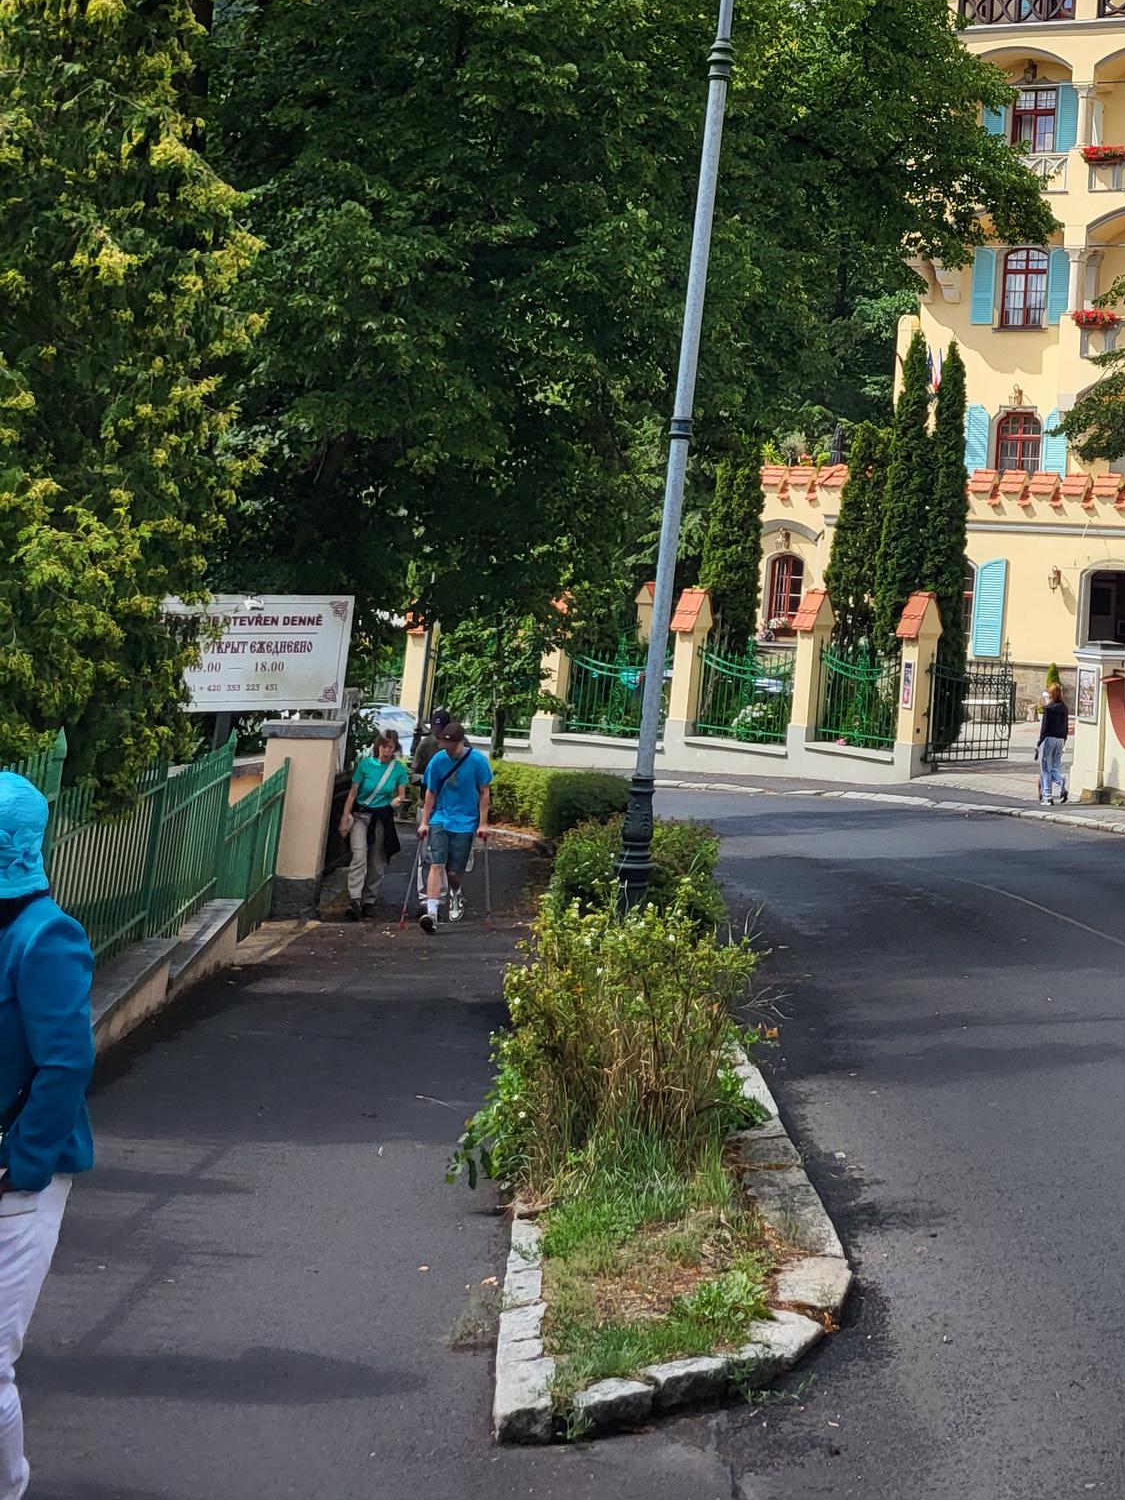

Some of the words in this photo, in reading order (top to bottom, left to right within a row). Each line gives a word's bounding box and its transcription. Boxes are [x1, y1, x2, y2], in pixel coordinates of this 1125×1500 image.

[282, 614, 323, 627] DENNĚ
[189, 662, 221, 673] 09.00
[254, 661, 285, 672] 18.00
